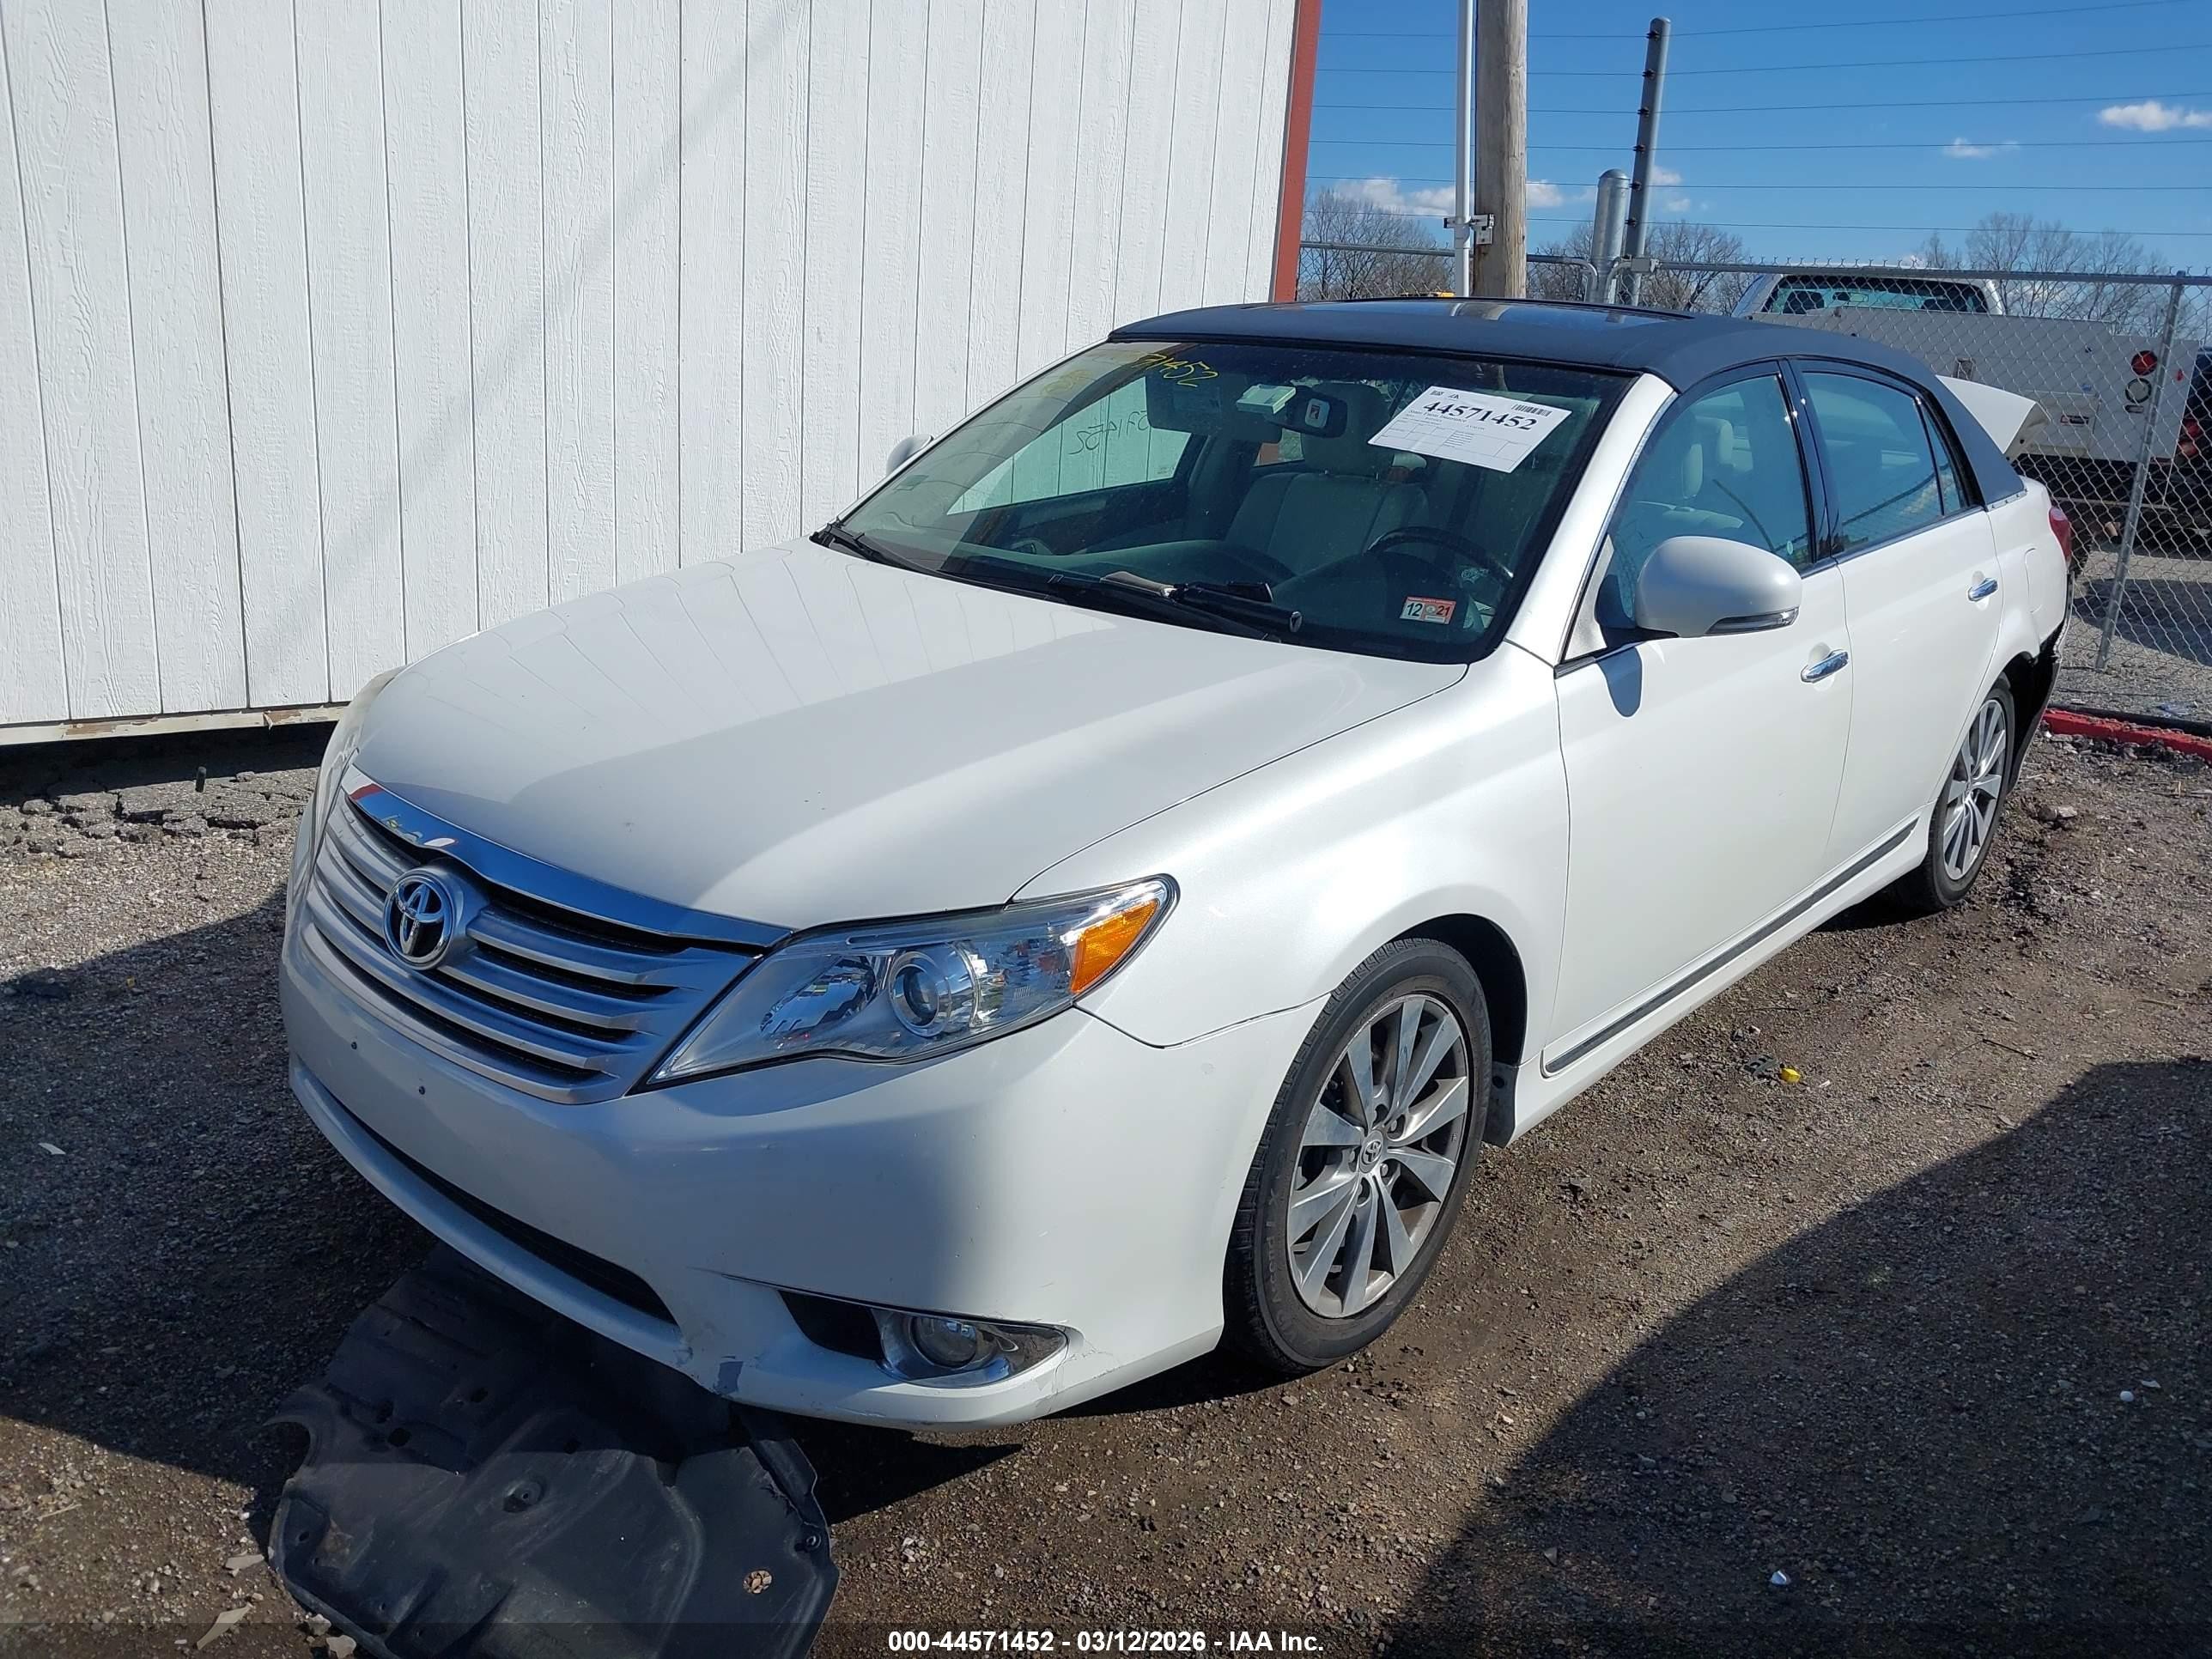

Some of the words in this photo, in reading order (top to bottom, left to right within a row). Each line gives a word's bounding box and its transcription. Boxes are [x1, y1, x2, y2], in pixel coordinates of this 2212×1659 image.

[1423, 401, 1537, 430] 44571452
[1407, 603, 1423, 617] 12
[1436, 605, 1451, 617] 21
